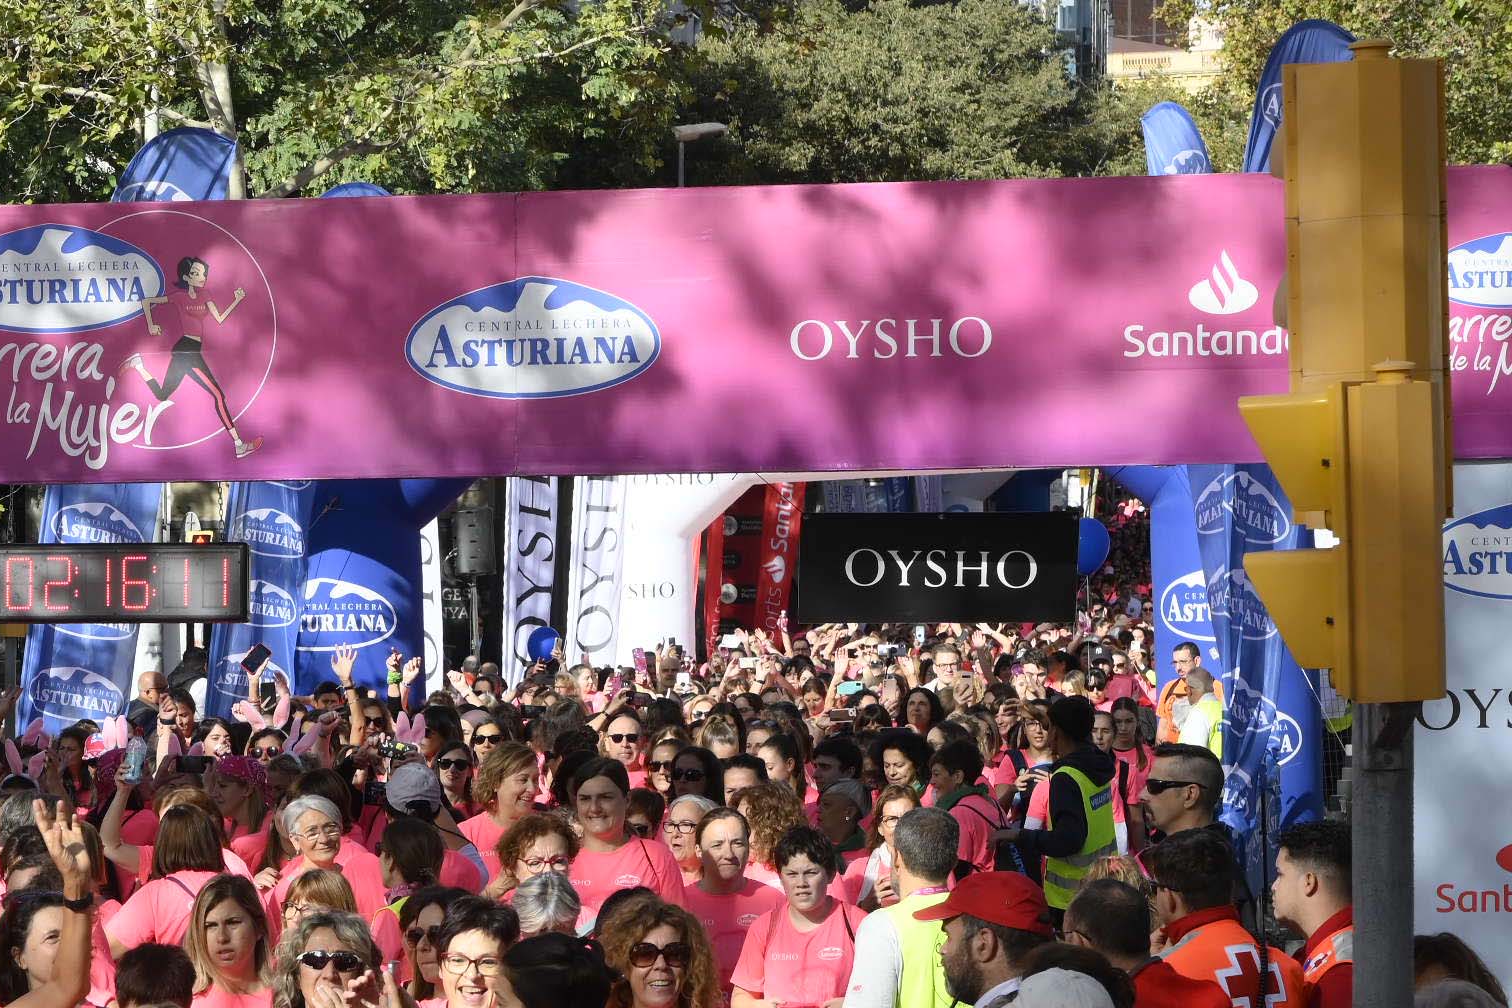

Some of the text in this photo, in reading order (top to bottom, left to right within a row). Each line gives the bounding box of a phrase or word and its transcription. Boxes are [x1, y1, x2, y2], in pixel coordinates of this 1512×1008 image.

[67, 261, 140, 273] LECHERA
[425, 323, 641, 369] ASTURIANA
[464, 318, 632, 333] CENTRAL LECHERA
[788, 315, 994, 362] OYSHO
[1473, 344, 1492, 371] la
[6, 386, 32, 425] la
[25, 375, 176, 470] Mujer
[5, 555, 230, 611] 02:16:11
[844, 546, 1039, 589] OYSHO
[334, 603, 384, 612] LECHERA
